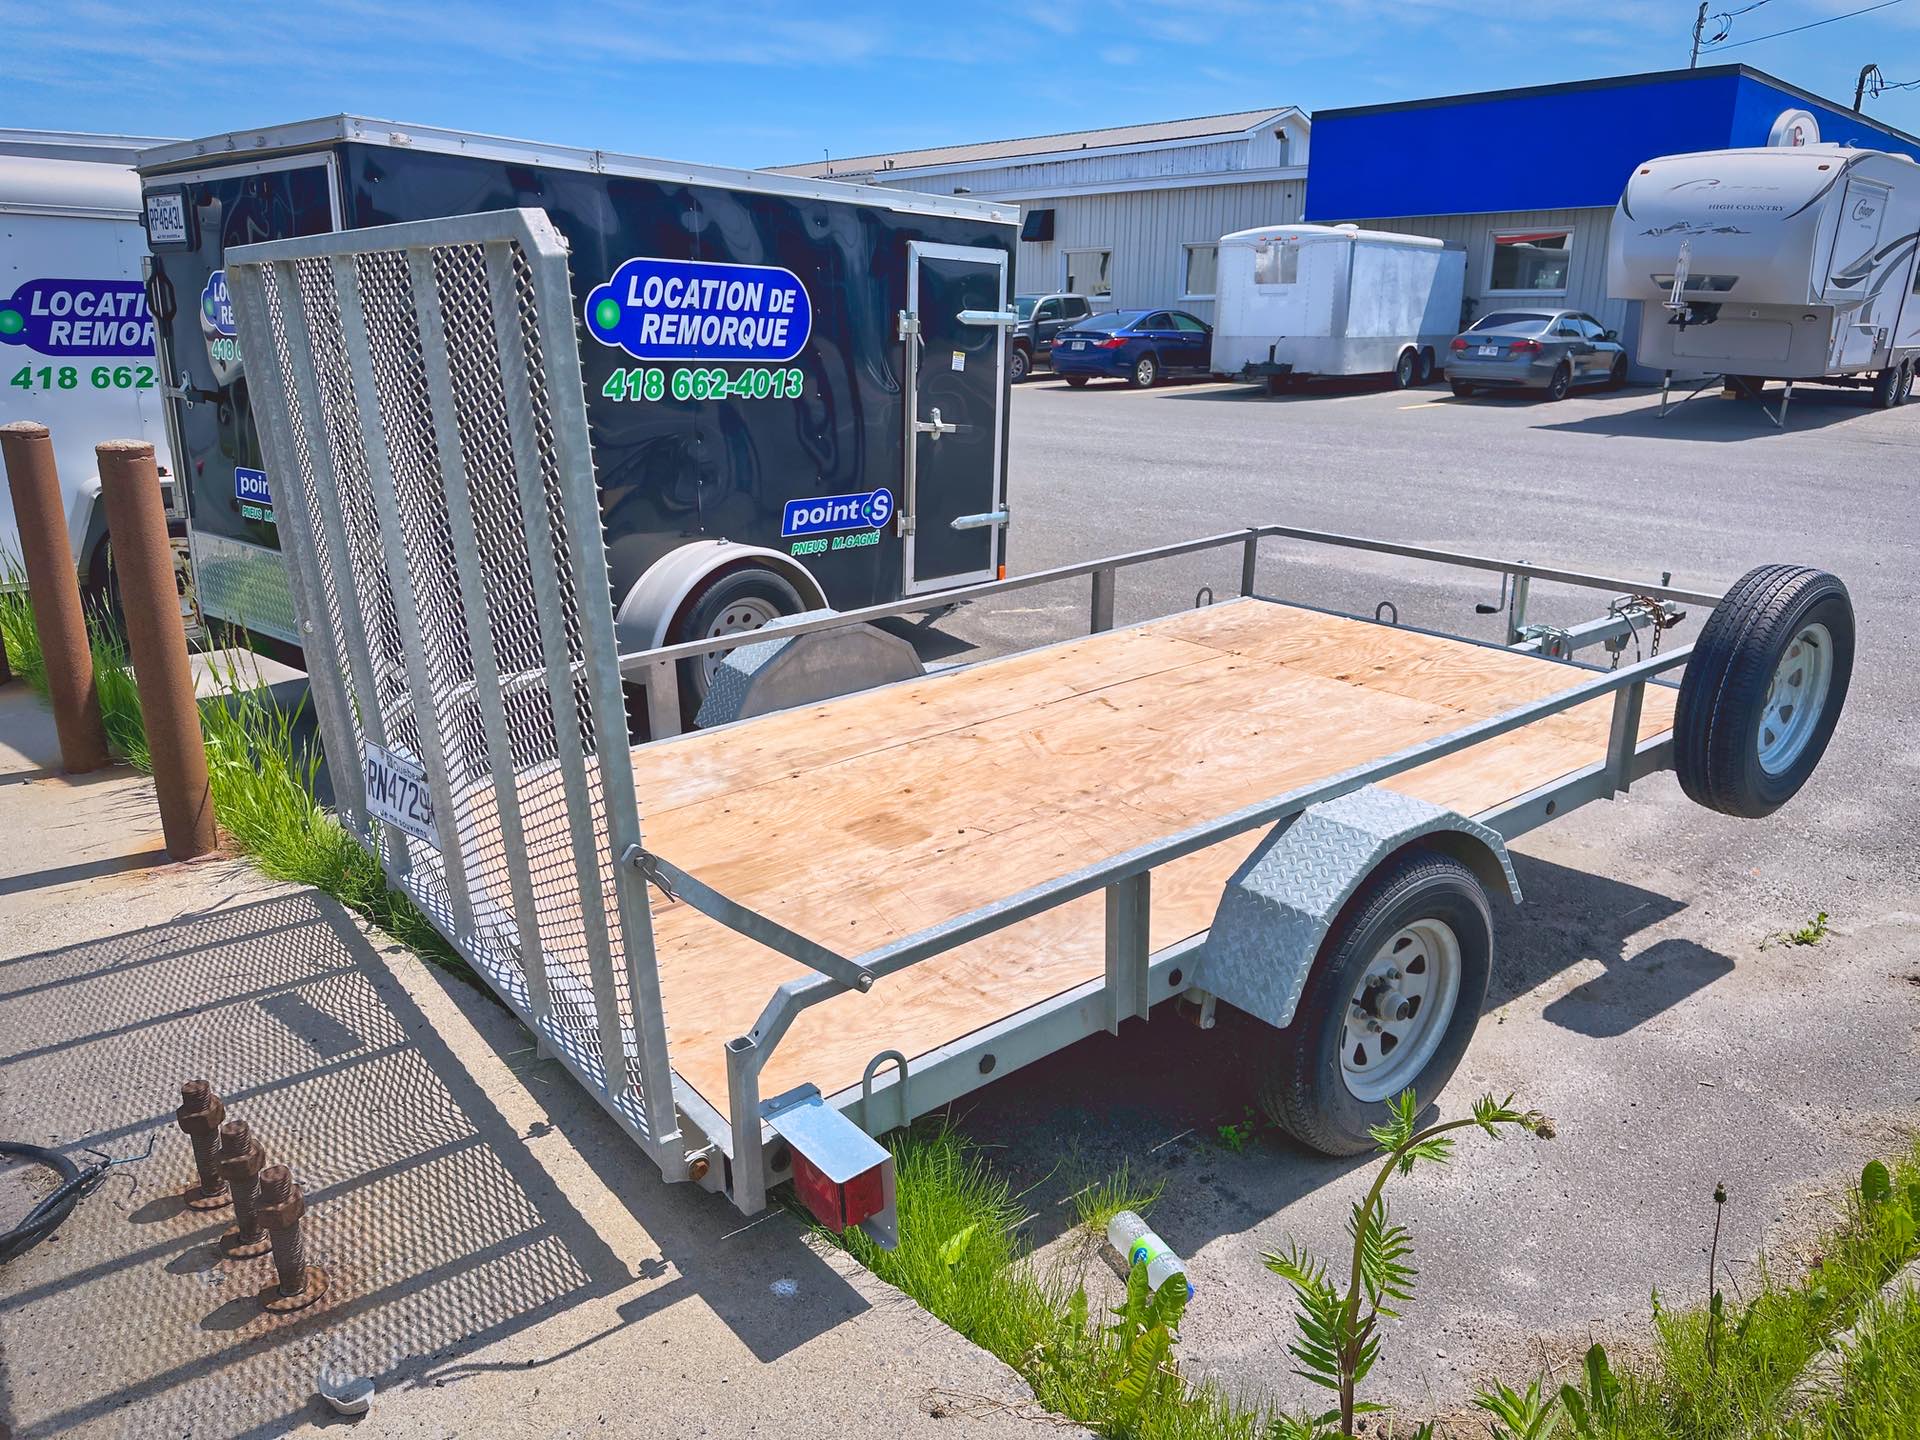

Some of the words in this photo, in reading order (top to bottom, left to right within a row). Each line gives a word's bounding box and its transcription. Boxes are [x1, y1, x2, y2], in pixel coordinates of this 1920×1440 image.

[150, 205, 184, 230] RP4643L
[1736, 203, 1785, 212] COUNTRY
[30, 290, 153, 317] LOCATI
[626, 275, 764, 313] LOCATION
[768, 288, 797, 313] DE
[640, 313, 790, 350] REMORQUE
[212, 338, 234, 361] 418
[10, 366, 78, 390] 418
[602, 368, 665, 401] 418
[671, 368, 804, 400] 662-4013
[791, 500, 860, 531] point
[871, 495, 889, 521] S
[791, 538, 828, 556] PNEUS
[831, 529, 881, 550] M.GAGNÉ
[367, 758, 436, 829] RN4729
